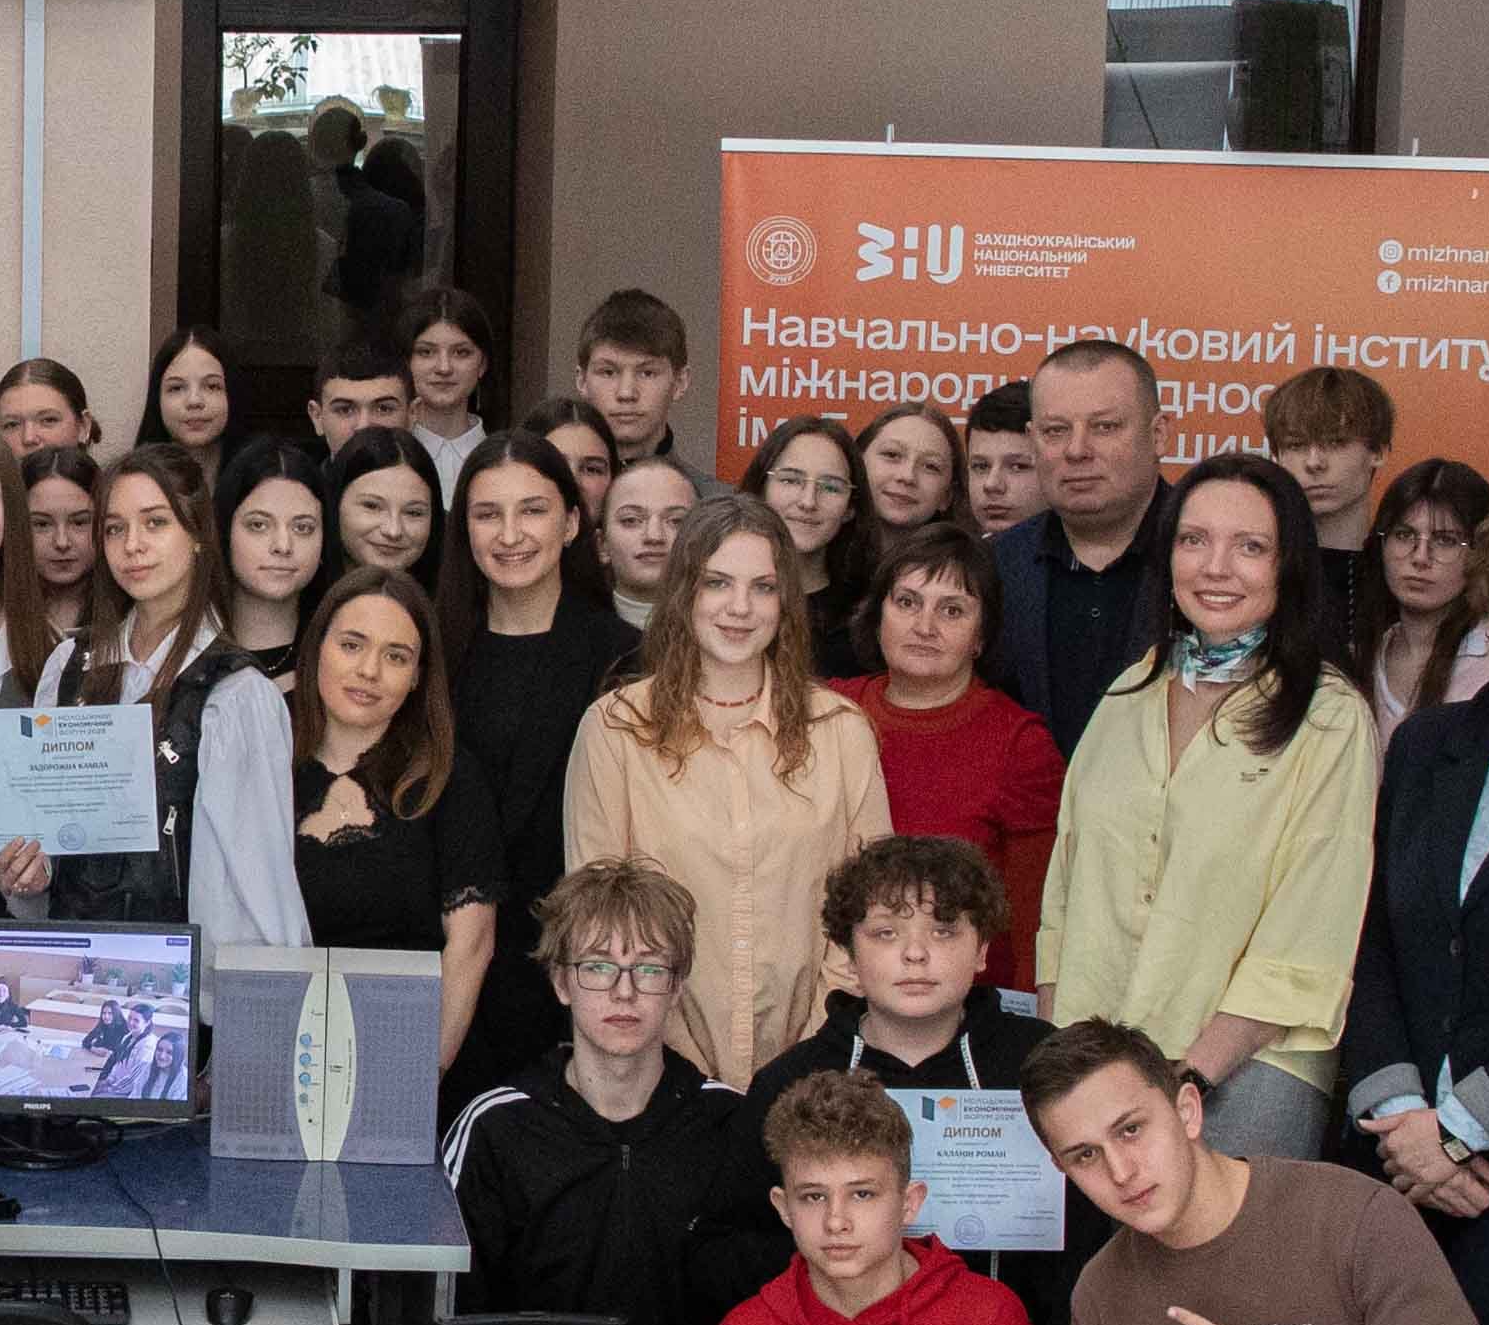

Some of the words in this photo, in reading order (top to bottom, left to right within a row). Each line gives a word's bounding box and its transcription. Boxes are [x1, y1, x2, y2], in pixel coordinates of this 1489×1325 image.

[974, 233, 1136, 250] ЗАХІДНОУКРАЇНСЬКИЙ
[974, 249, 1088, 264] НАЦІОНАЛЬНИЙ
[974, 263, 1070, 278] УНІВЕРСИТЕТ
[41, 741, 94, 754] ДИПЛОМ
[943, 1126, 1002, 1138] ДИПЛОМ
